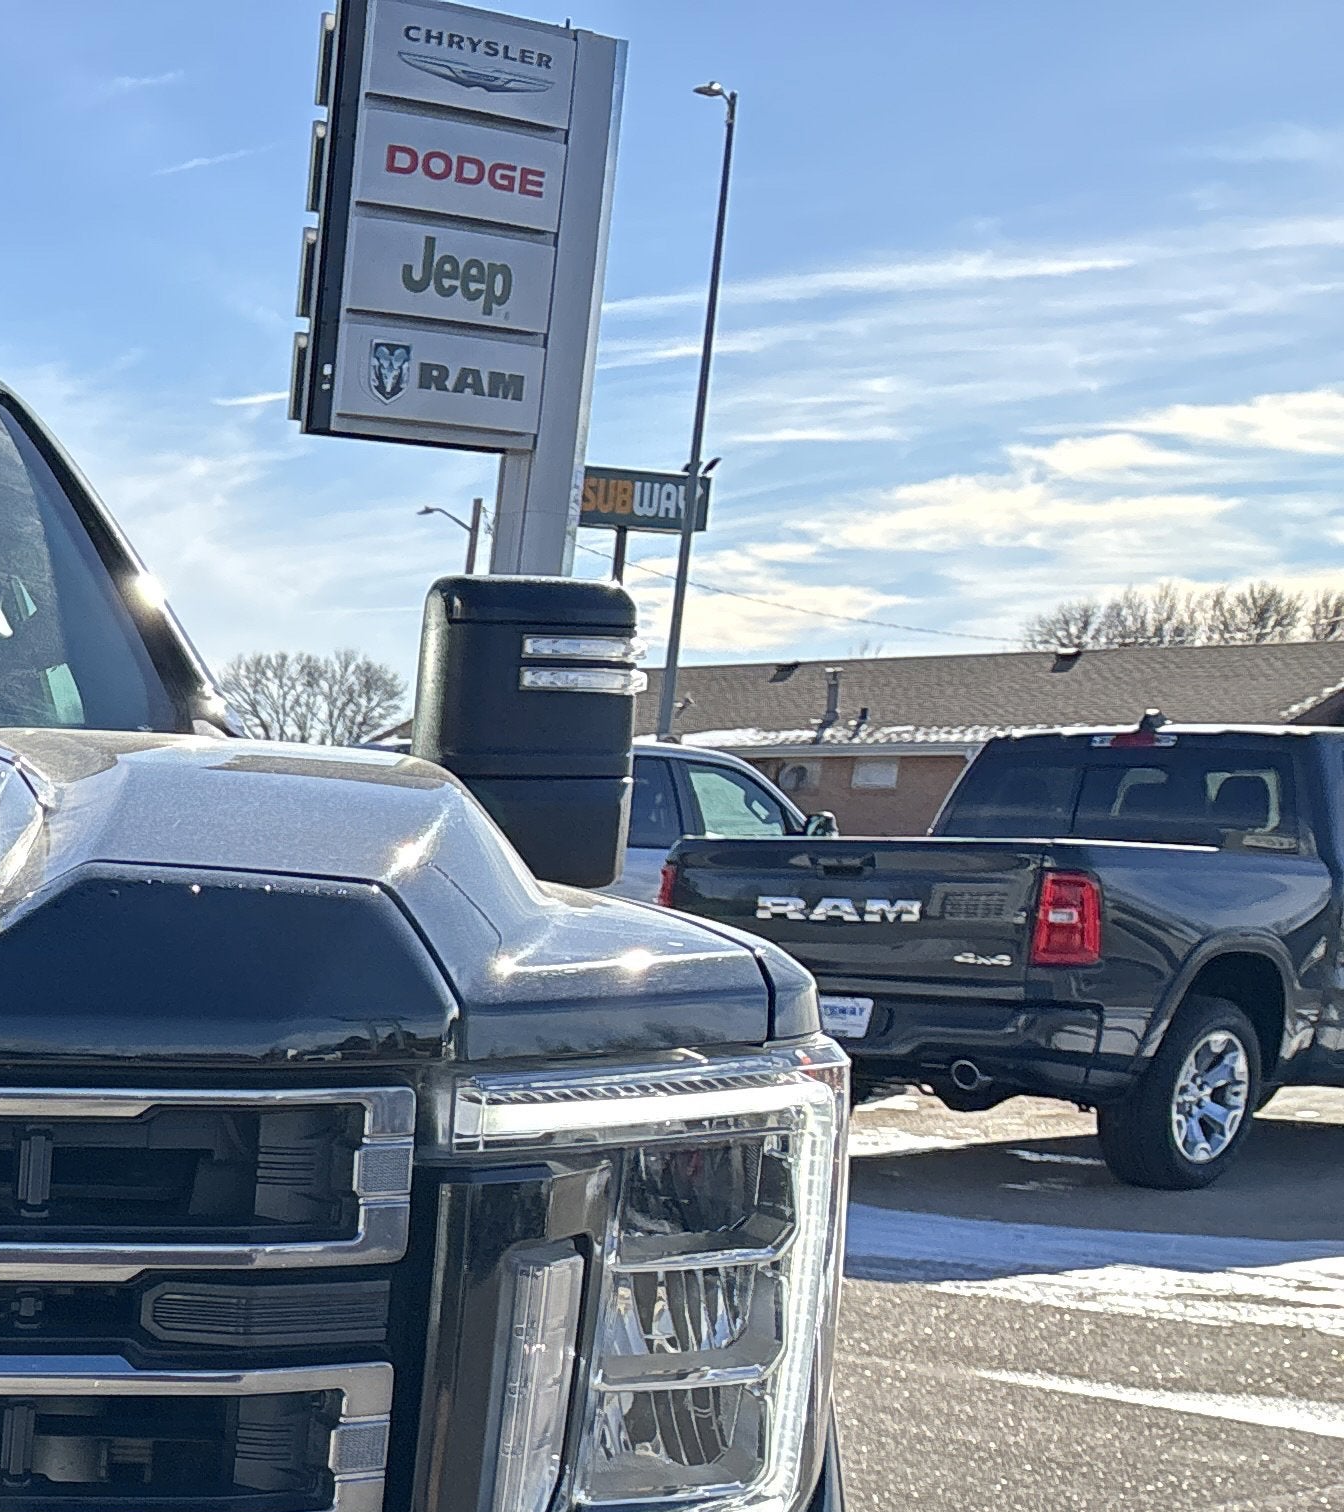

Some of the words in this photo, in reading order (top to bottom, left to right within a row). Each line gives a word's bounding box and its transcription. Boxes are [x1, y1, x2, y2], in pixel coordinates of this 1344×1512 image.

[404, 25, 553, 70] CHRYSLER
[386, 143, 546, 199] DODGE
[402, 235, 512, 316] Jeep
[418, 361, 525, 402] RAM
[756, 895, 922, 923] RAM
